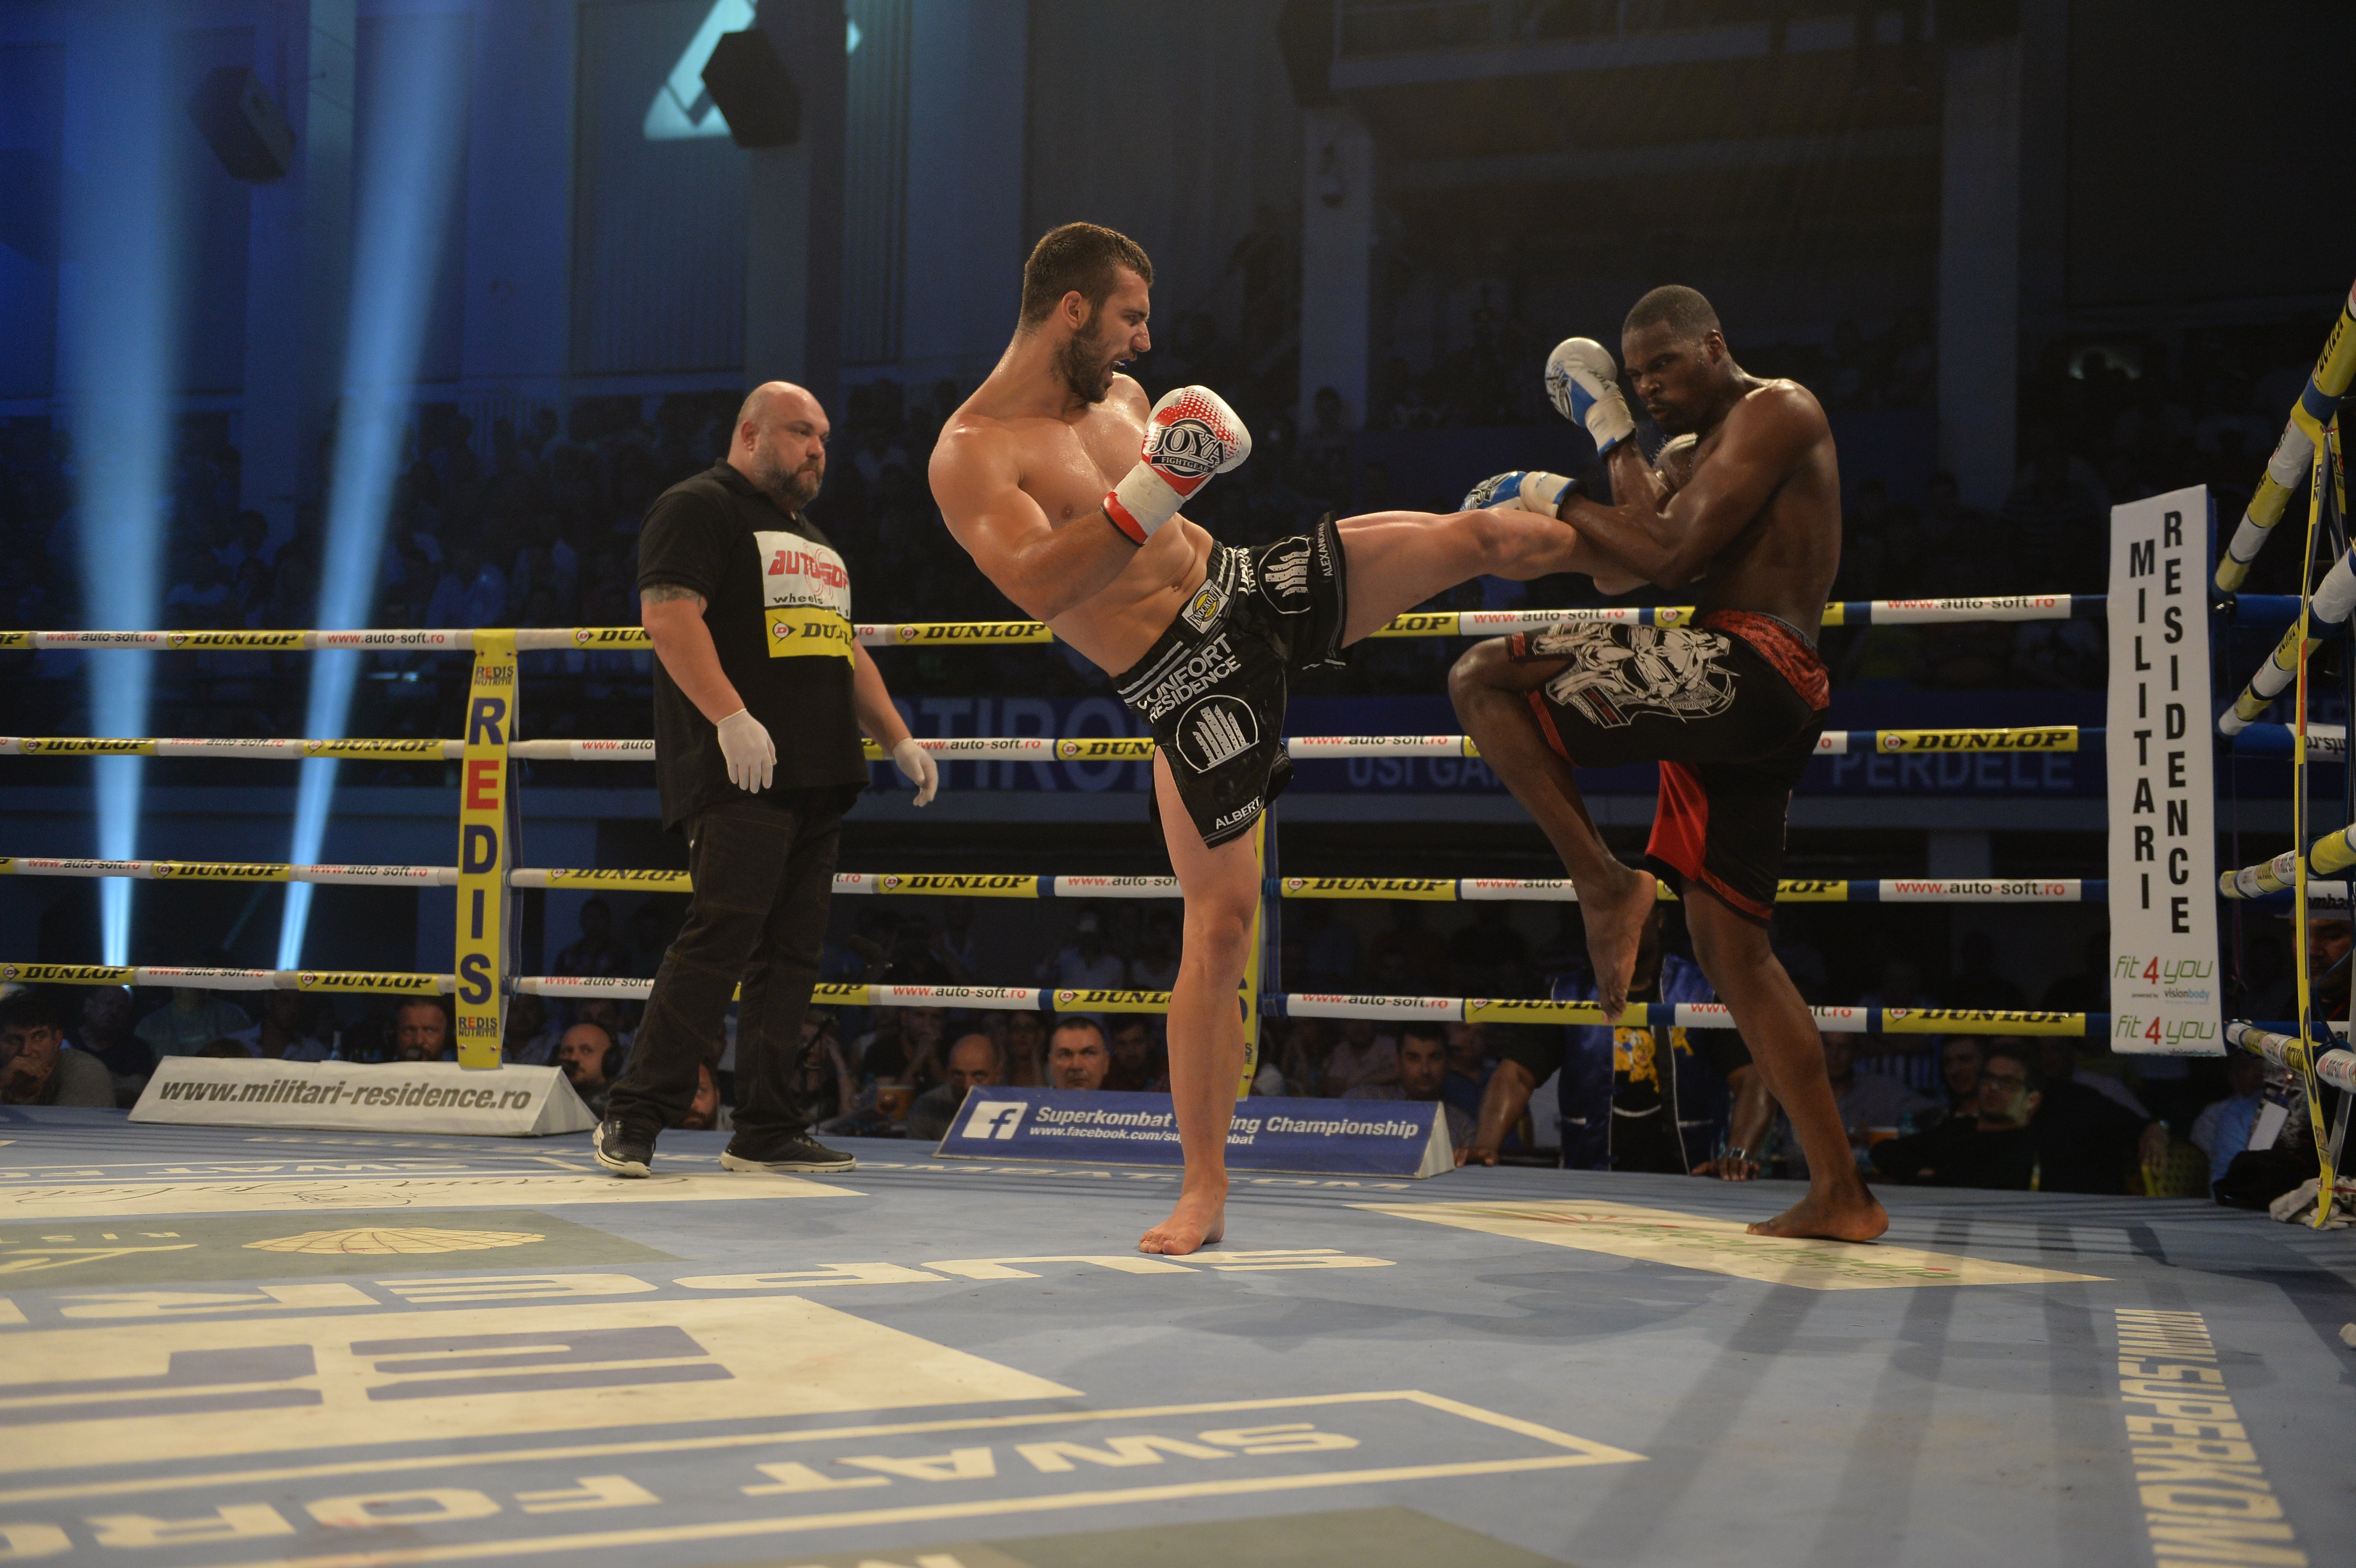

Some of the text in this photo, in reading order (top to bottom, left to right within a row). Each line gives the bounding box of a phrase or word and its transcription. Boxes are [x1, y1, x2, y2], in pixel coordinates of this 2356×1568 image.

[1148, 425, 1225, 467] JOYA
[1161, 457, 1209, 473] FIGHTGEAR
[773, 594, 823, 604] wheels
[1189, 587, 1221, 627] KNOCKOUT
[46, 632, 157, 642] www.auto-soft.ro
[192, 632, 299, 645] DUNLOP
[327, 632, 444, 644] www.auto-soft.ro
[598, 630, 652, 641] DUN
[923, 625, 1046, 639] DUNLOP
[476, 665, 514, 678] REDIS
[1149, 654, 1241, 723] RESIDENCE
[45, 739, 148, 750] DUNLOP
[328, 740, 438, 751] DUNLOP
[916, 739, 1041, 750] ww.auto-soft.ro
[1913, 732, 2070, 749] DUNLOP
[1087, 742, 1154, 755] DUN
[1215, 796, 1261, 830] ALBERT
[458, 697, 506, 1005] REDIS
[178, 865, 286, 876] DUNLOP
[311, 865, 427, 877] www.auto-soft.ro
[573, 869, 690, 880] DUNLOP
[907, 876, 1031, 888] DUNLOP
[1312, 879, 1448, 891] DUNLOP
[1895, 881, 2065, 896] www.auto-soft.ro
[23, 967, 128, 980] DUNLOP
[321, 975, 432, 988] DUNLOP
[894, 986, 1026, 999] www.auto-soft.ro
[1083, 991, 1172, 1004] DUNL
[2164, 988, 2210, 1000] visionbody
[1302, 993, 1448, 1009] www.auto-soft.ro
[458, 1017, 497, 1029] REDIS
[458, 1028, 498, 1038] NUTRITIE
[159, 1079, 531, 1110] www.militari-residence.ro
[1036, 1107, 1173, 1128] Superkombat
[1267, 1116, 1418, 1139] Championship
[0, 1248, 1397, 1324] SUPER
[2115, 1308, 2309, 1568] WWW.SUPERKOM
[742, 1422, 1362, 1497] SWAT
